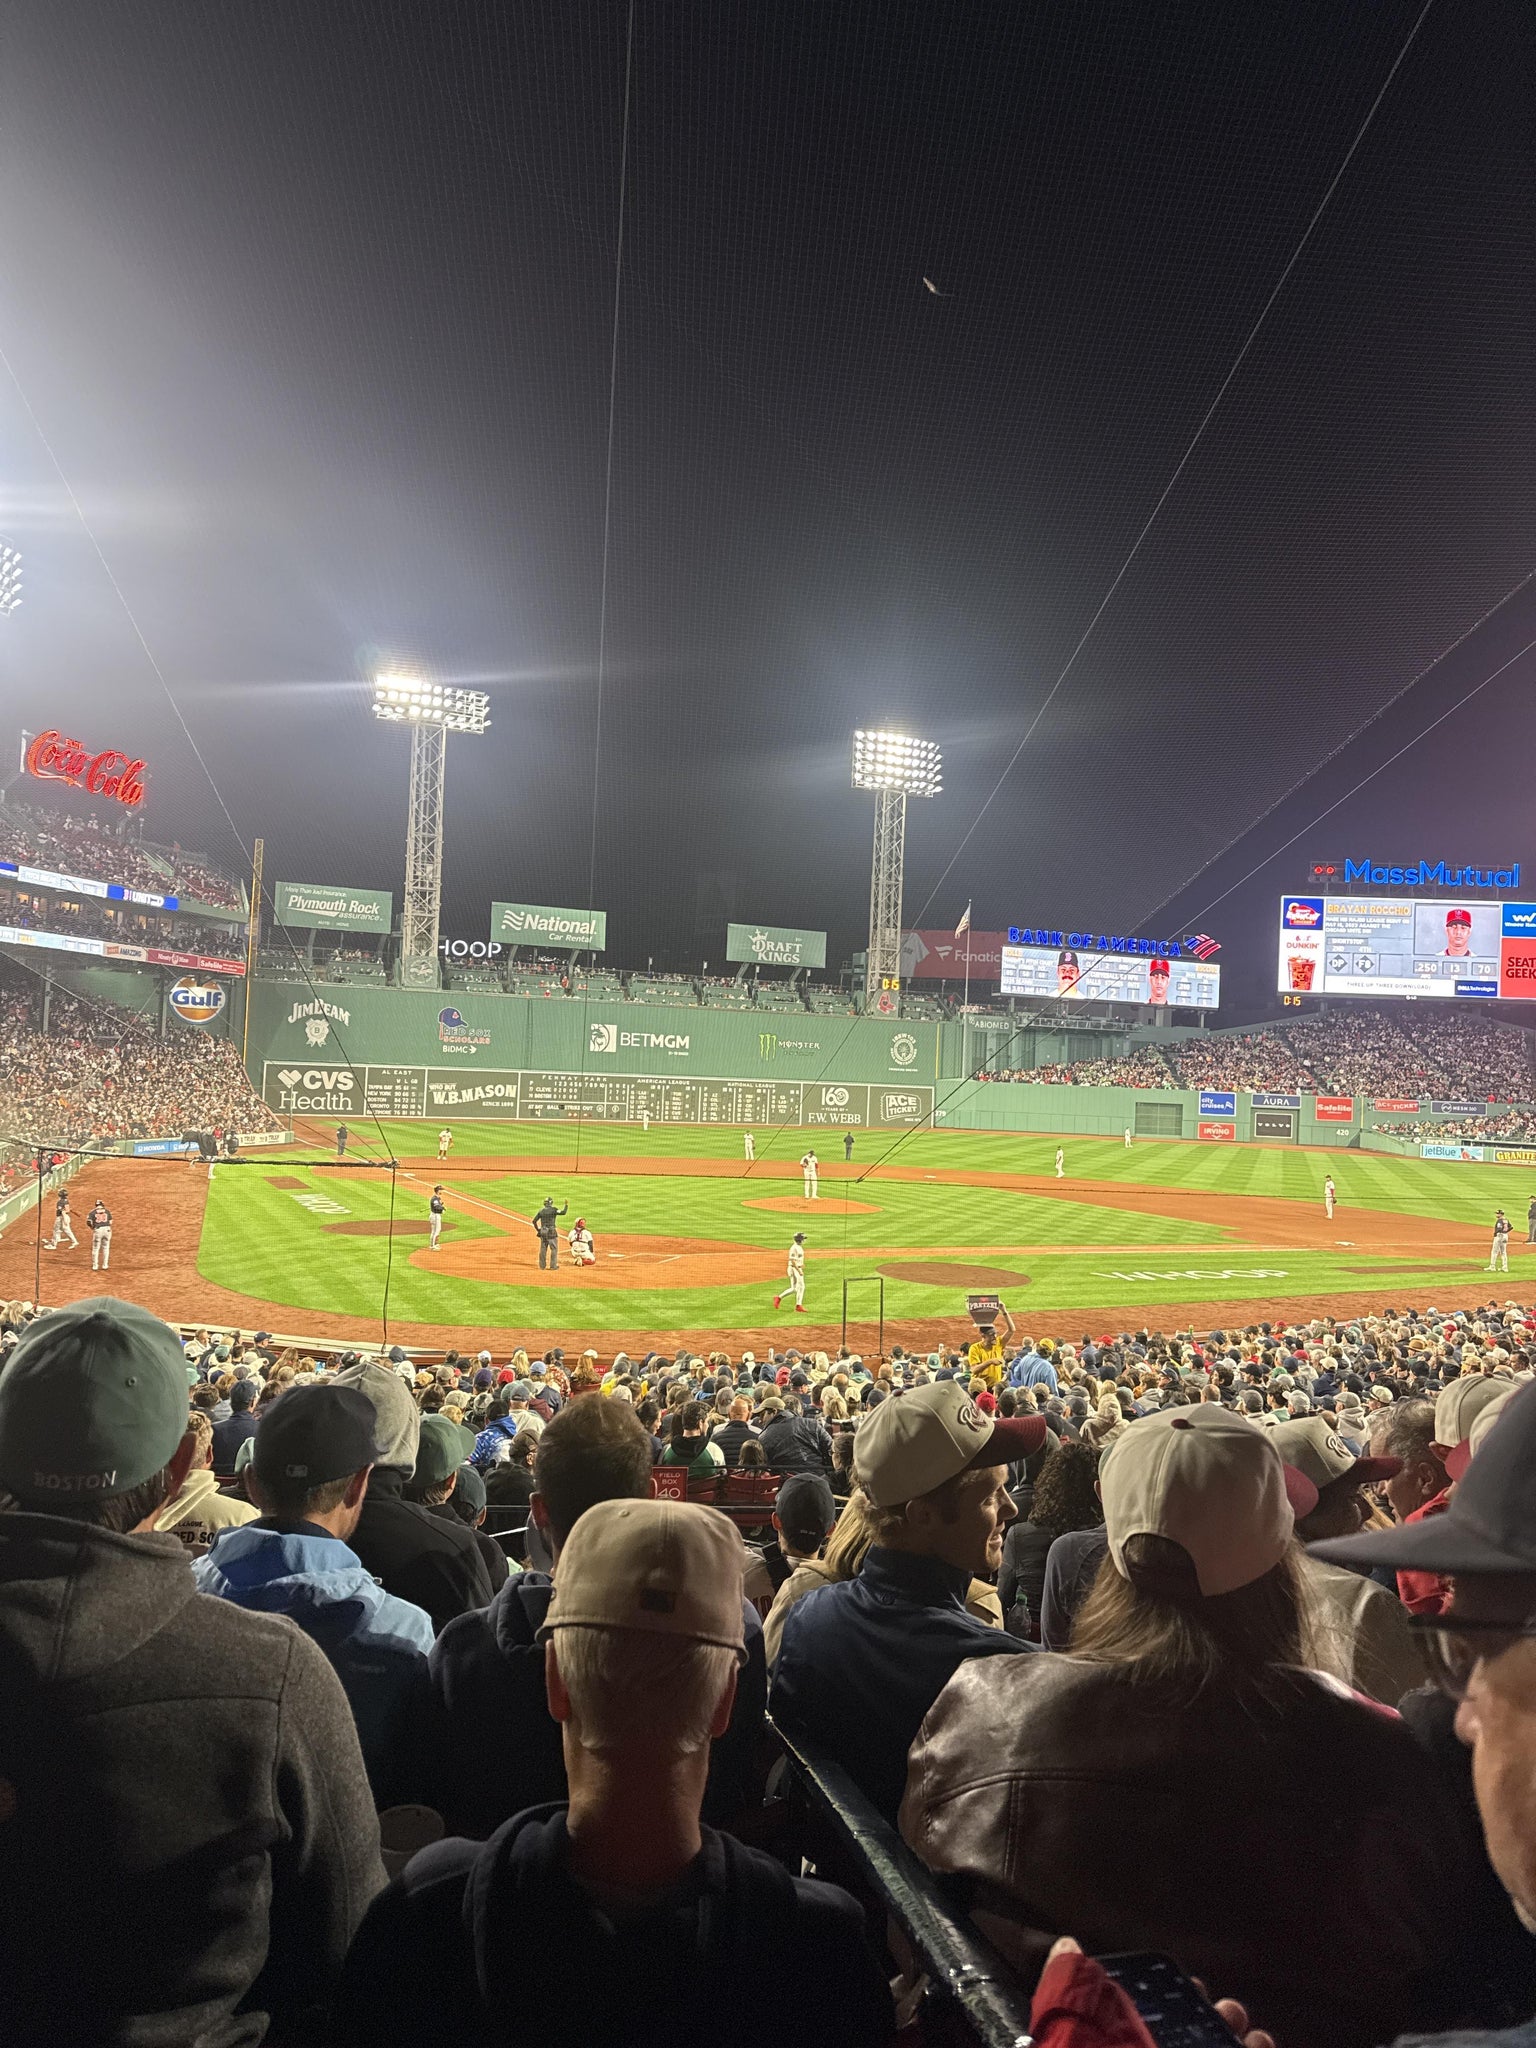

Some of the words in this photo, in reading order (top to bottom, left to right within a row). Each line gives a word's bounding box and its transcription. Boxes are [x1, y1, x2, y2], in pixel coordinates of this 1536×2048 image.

[1344, 858, 1520, 888] MassMutual
[288, 895, 346, 911] Plymouth
[349, 900, 380, 914] Rock
[1328, 904, 1367, 914] BRAYAN
[1370, 906, 1410, 916] ROCCHIO
[339, 911, 380, 922] assurance
[524, 914, 596, 934] National
[549, 933, 563, 941] Car
[566, 935, 592, 943] Rental
[1008, 927, 1063, 946] BANK
[1068, 933, 1093, 949] OF
[1096, 935, 1182, 957] AMERICA
[752, 940, 803, 953] DRAFT
[758, 951, 800, 963] KINGS
[1331, 959, 1344, 968] DP
[1415, 964, 1437, 973] .250
[1450, 965, 1460, 974] 13
[1478, 966, 1490, 974] 70
[1506, 969, 1536, 979] GEEK
[172, 988, 224, 1007] Gulf
[1110, 989, 1117, 999] 2
[1283, 995, 1301, 1006] 0:15
[288, 1003, 314, 1023] JIM
[314, 999, 351, 1027] BEAM
[975, 1021, 1009, 1030] ABIOMED
[444, 1028, 466, 1036] RED
[444, 1036, 491, 1045] SCHOLARS
[620, 1032, 690, 1049] BETMGM
[779, 1040, 820, 1049] MONSTER
[303, 1070, 354, 1090] CVS
[279, 1092, 352, 1110] Health
[821, 1087, 849, 1106] 160
[888, 1095, 917, 1107] ACE
[889, 1106, 917, 1114] TICKET
[1317, 1103, 1352, 1112] Safelite
[808, 1113, 827, 1123] F.W.
[830, 1113, 861, 1124] WEBB
[1204, 1127, 1230, 1135] IRVING
[1424, 1146, 1456, 1158] jetBlue
[1496, 1151, 1536, 1161] GRANITE
[33, 1470, 117, 1491] BOSTON
[657, 1487, 680, 1499] 40
